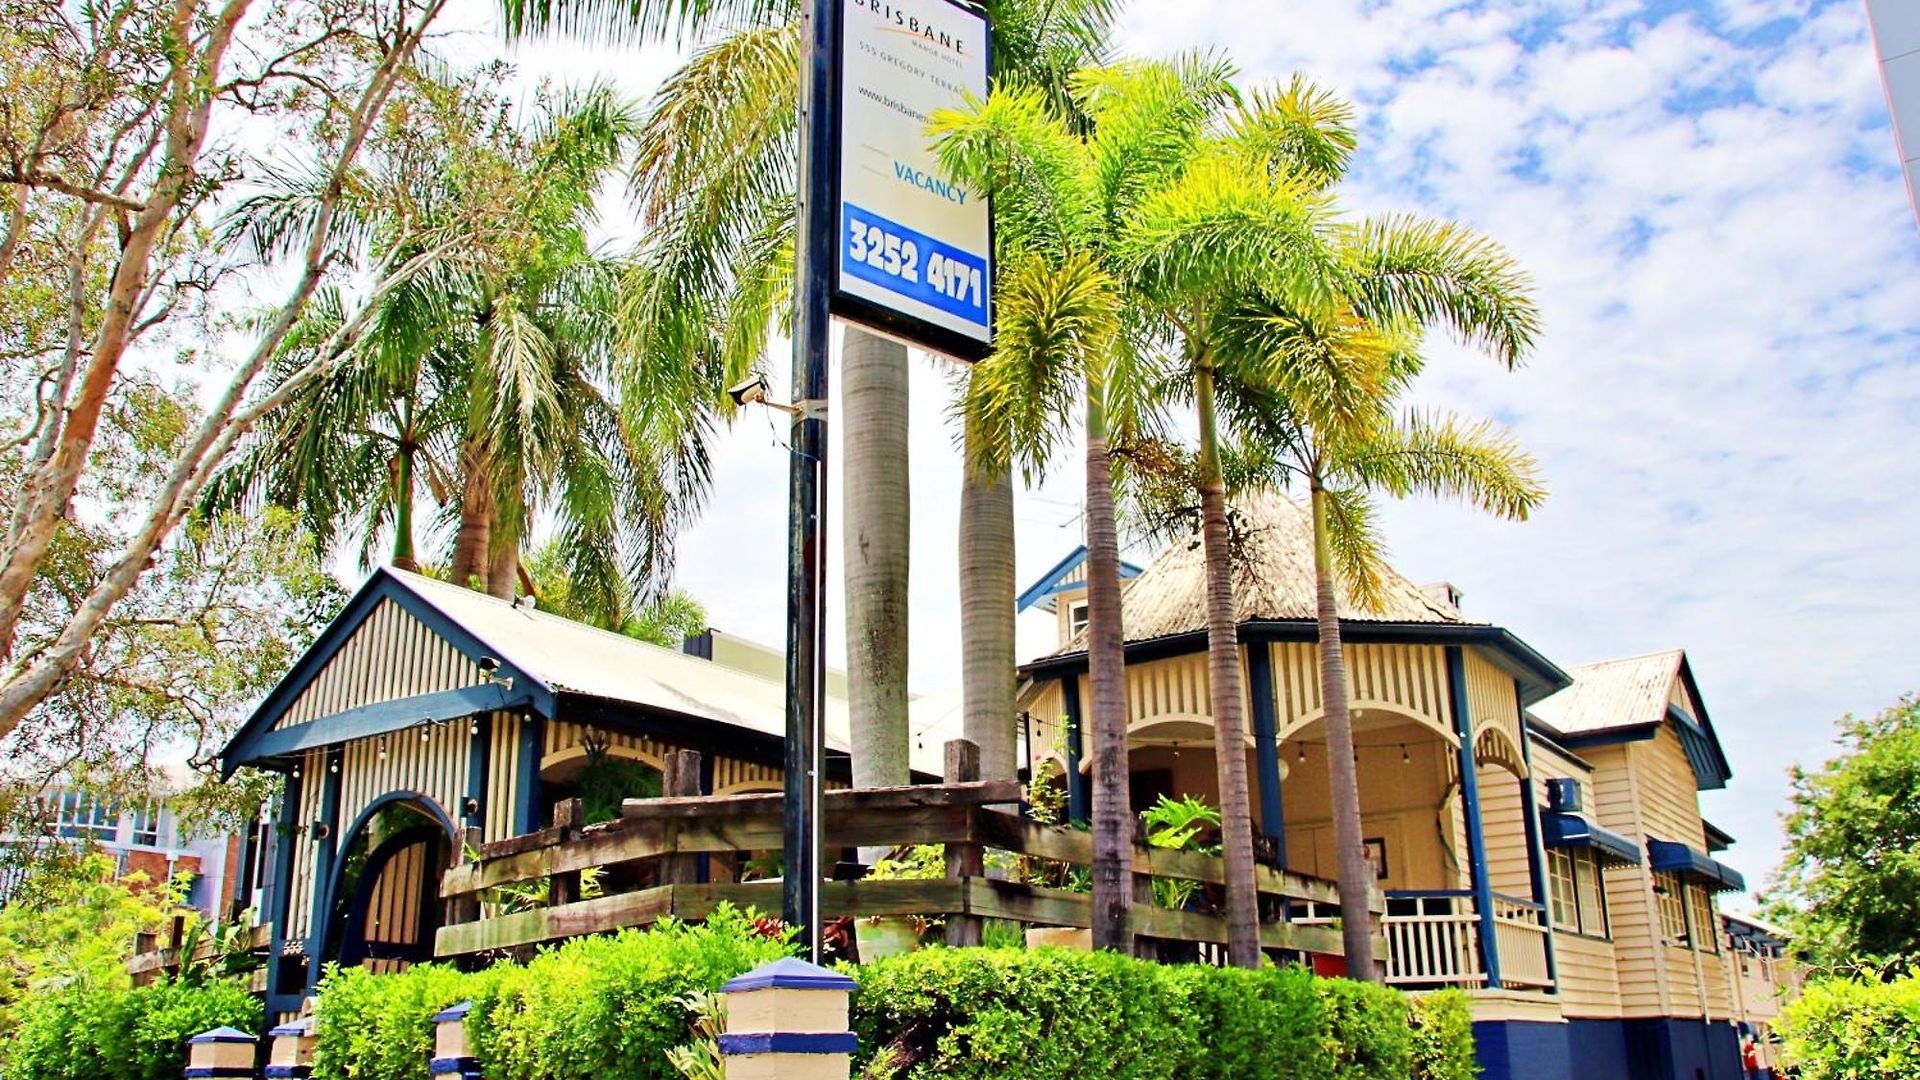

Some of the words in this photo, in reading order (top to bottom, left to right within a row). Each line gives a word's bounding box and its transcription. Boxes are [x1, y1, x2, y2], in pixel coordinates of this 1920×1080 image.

[880, 51, 925, 79] GREGORY
[930, 74, 964, 96] TERRA
[894, 160, 966, 206] VACANCY
[849, 217, 920, 284] 3252
[927, 251, 982, 309] 4171
